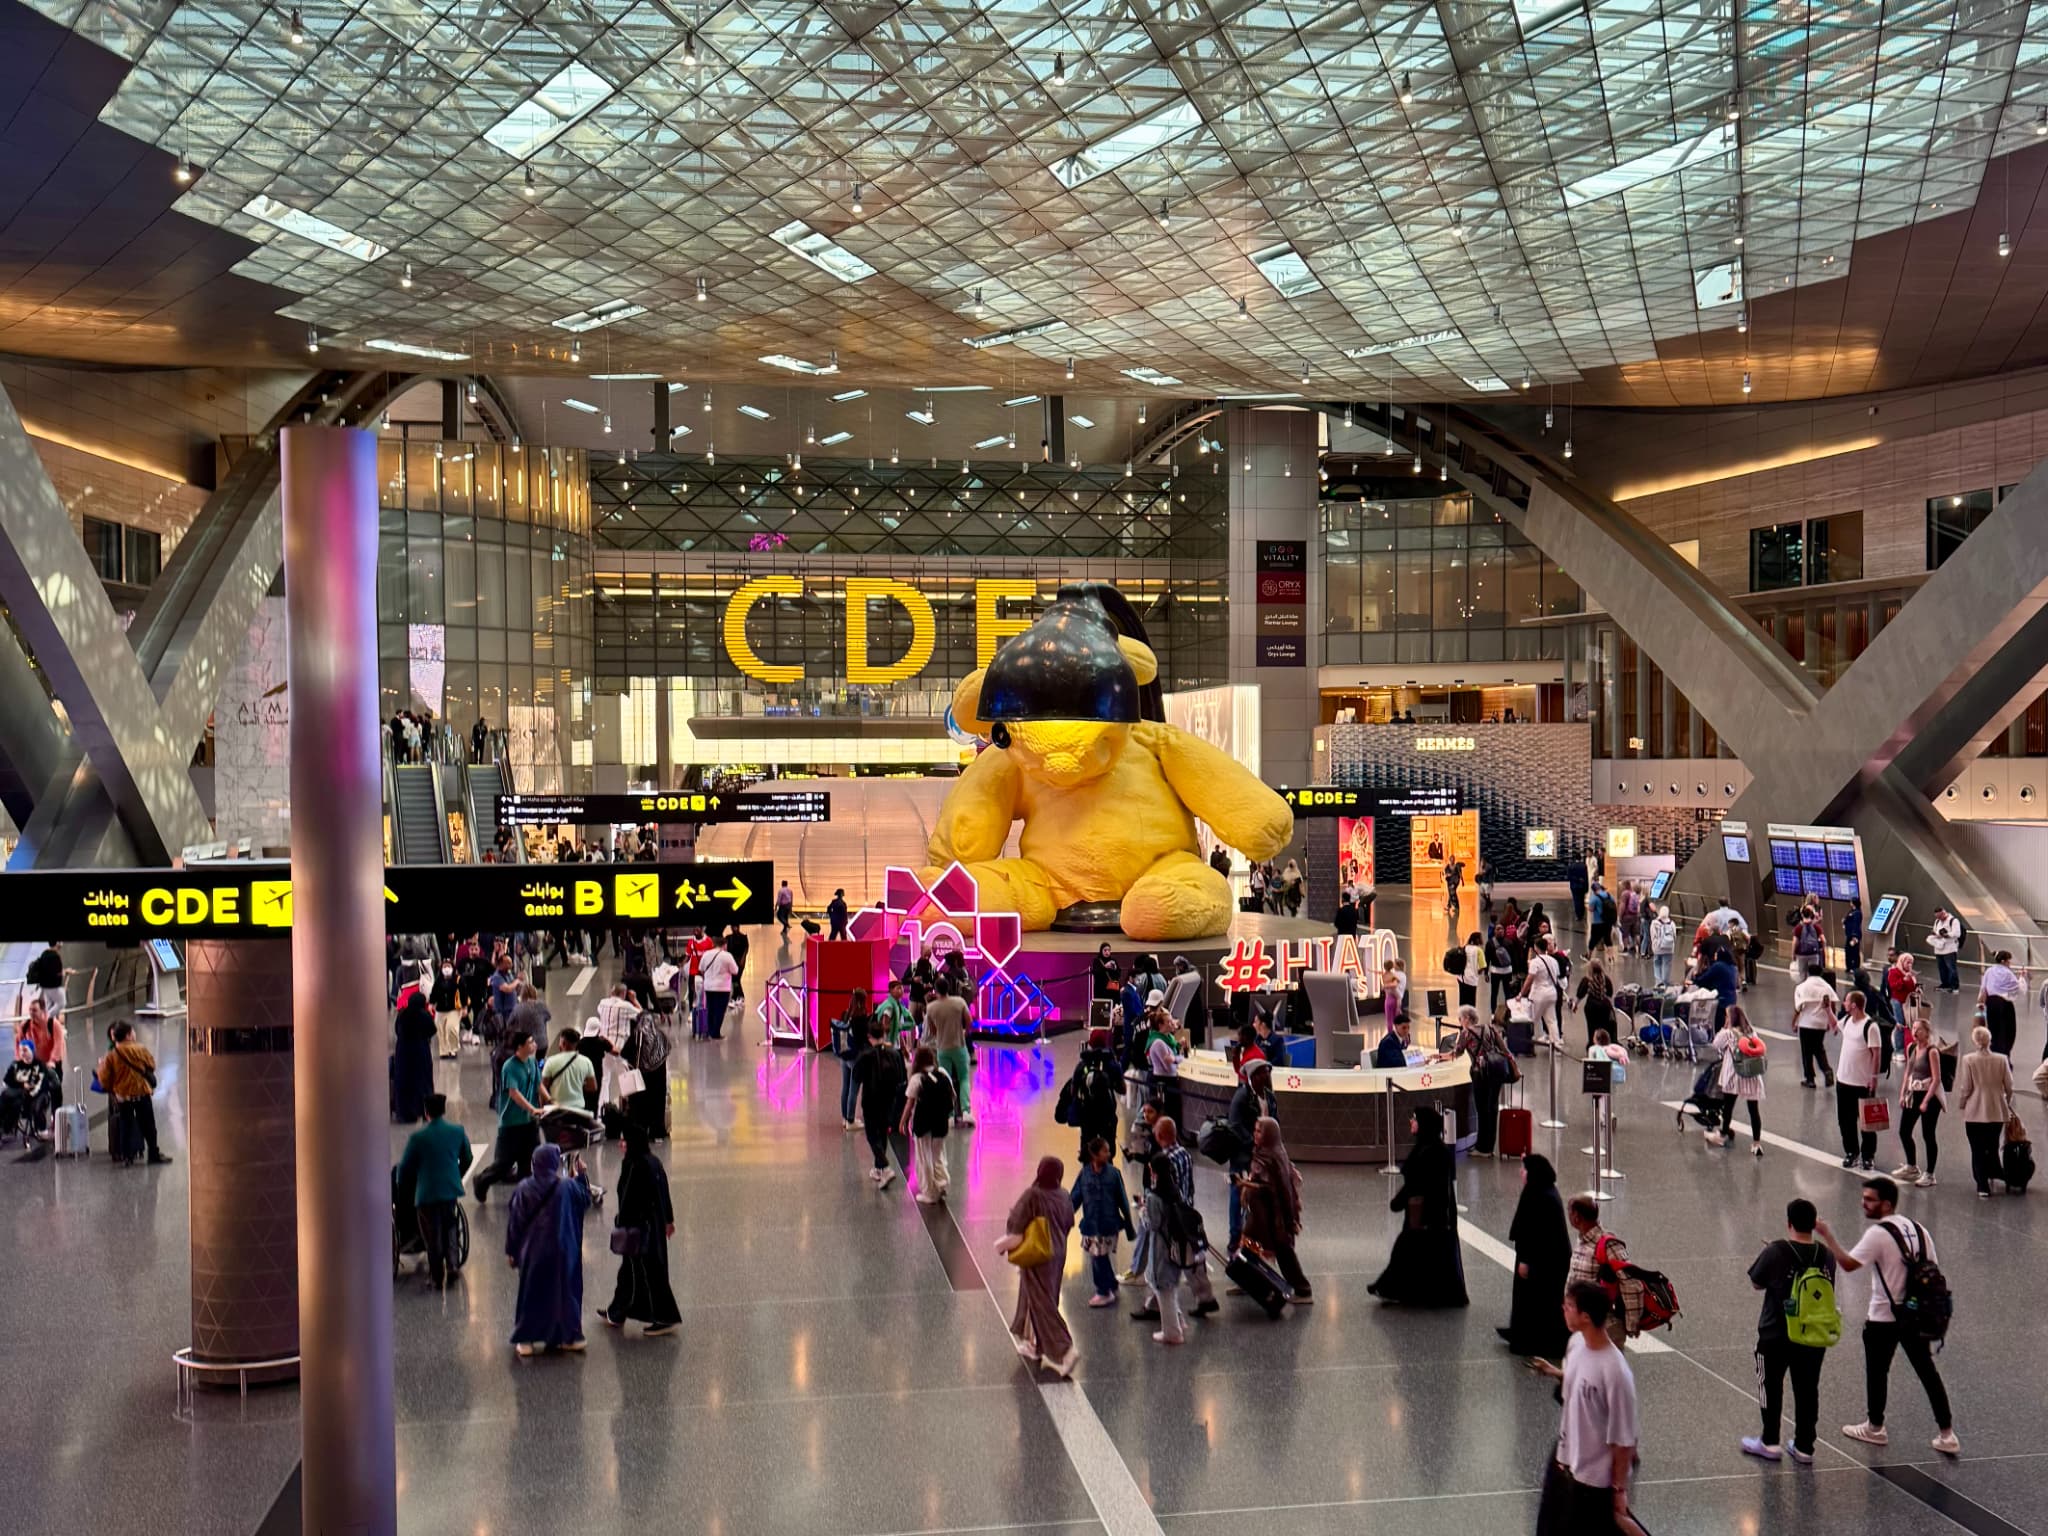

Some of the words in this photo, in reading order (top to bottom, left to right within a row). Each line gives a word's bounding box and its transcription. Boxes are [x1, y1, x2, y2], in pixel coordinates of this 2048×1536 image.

[1278, 580, 1301, 588] ORYX
[656, 797, 689, 811] CDE
[1314, 791, 1344, 804] CDE
[521, 882, 564, 900] بوابات
[575, 880, 604, 915] B
[83, 890, 129, 908] بوابات
[141, 887, 240, 925] CDE
[525, 903, 564, 917] Gates
[88, 913, 129, 926] Gates
[935, 940, 953, 949] YEAR
